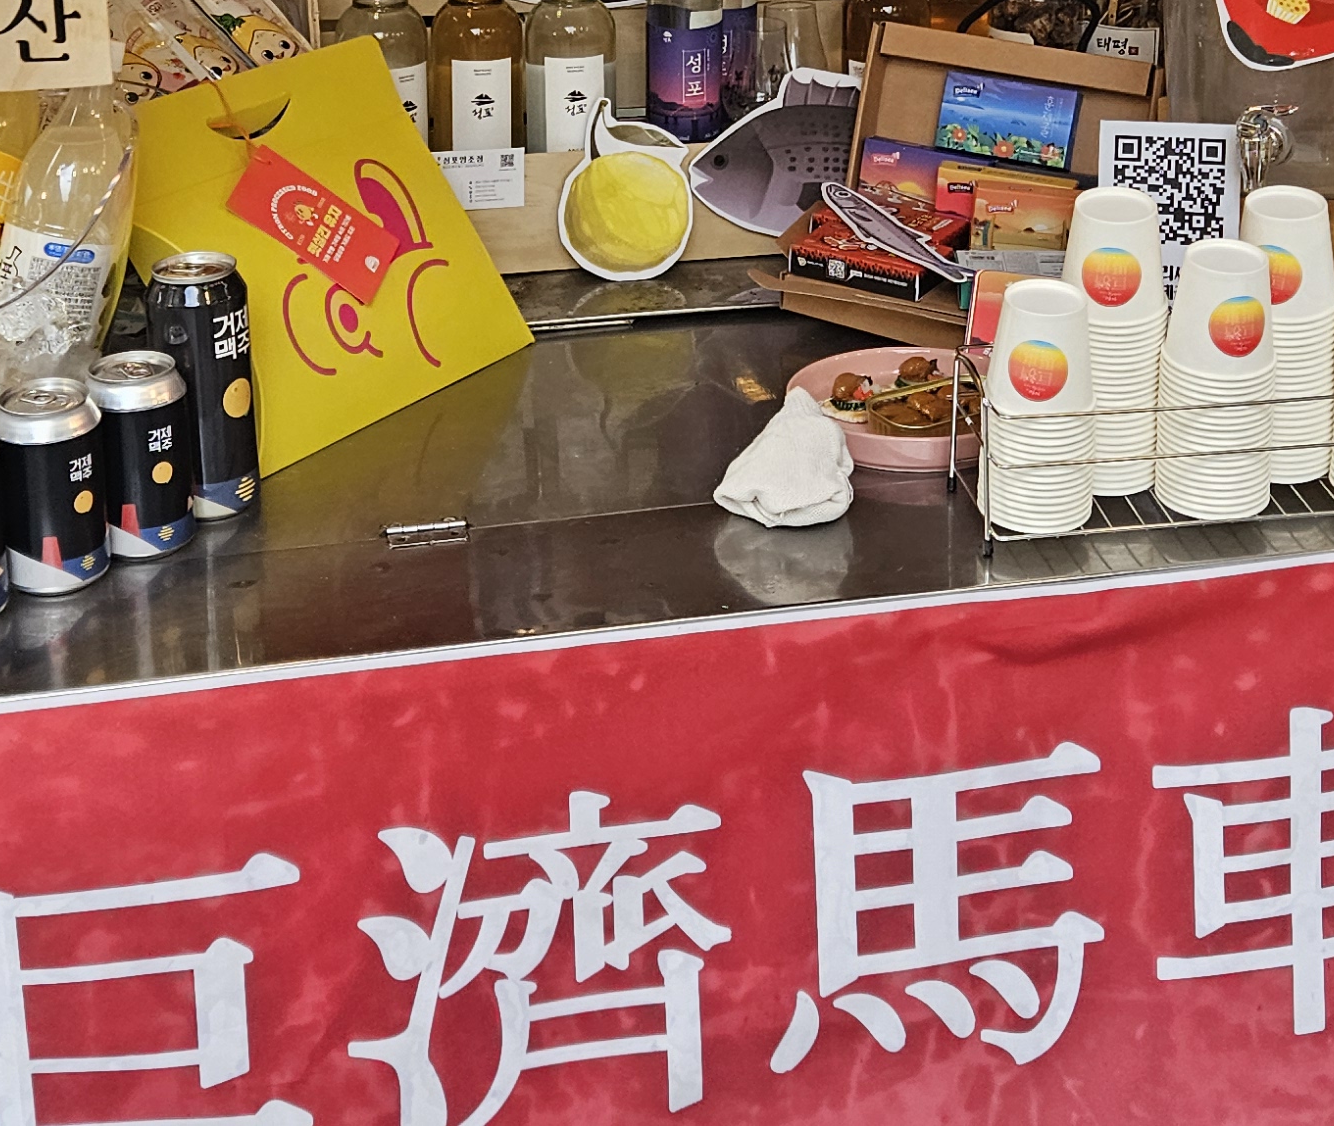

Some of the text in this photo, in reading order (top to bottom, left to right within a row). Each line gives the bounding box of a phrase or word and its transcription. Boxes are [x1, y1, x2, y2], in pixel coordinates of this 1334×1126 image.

[1096, 36, 1129, 56] 태평
[685, 51, 706, 98] 성포
[212, 303, 249, 339] 거제
[213, 329, 250, 360] 맥주
[147, 424, 173, 441] 거제
[148, 438, 173, 454] 맥주
[69, 453, 93, 472] 거제
[69, 466, 93, 483] 맥주
